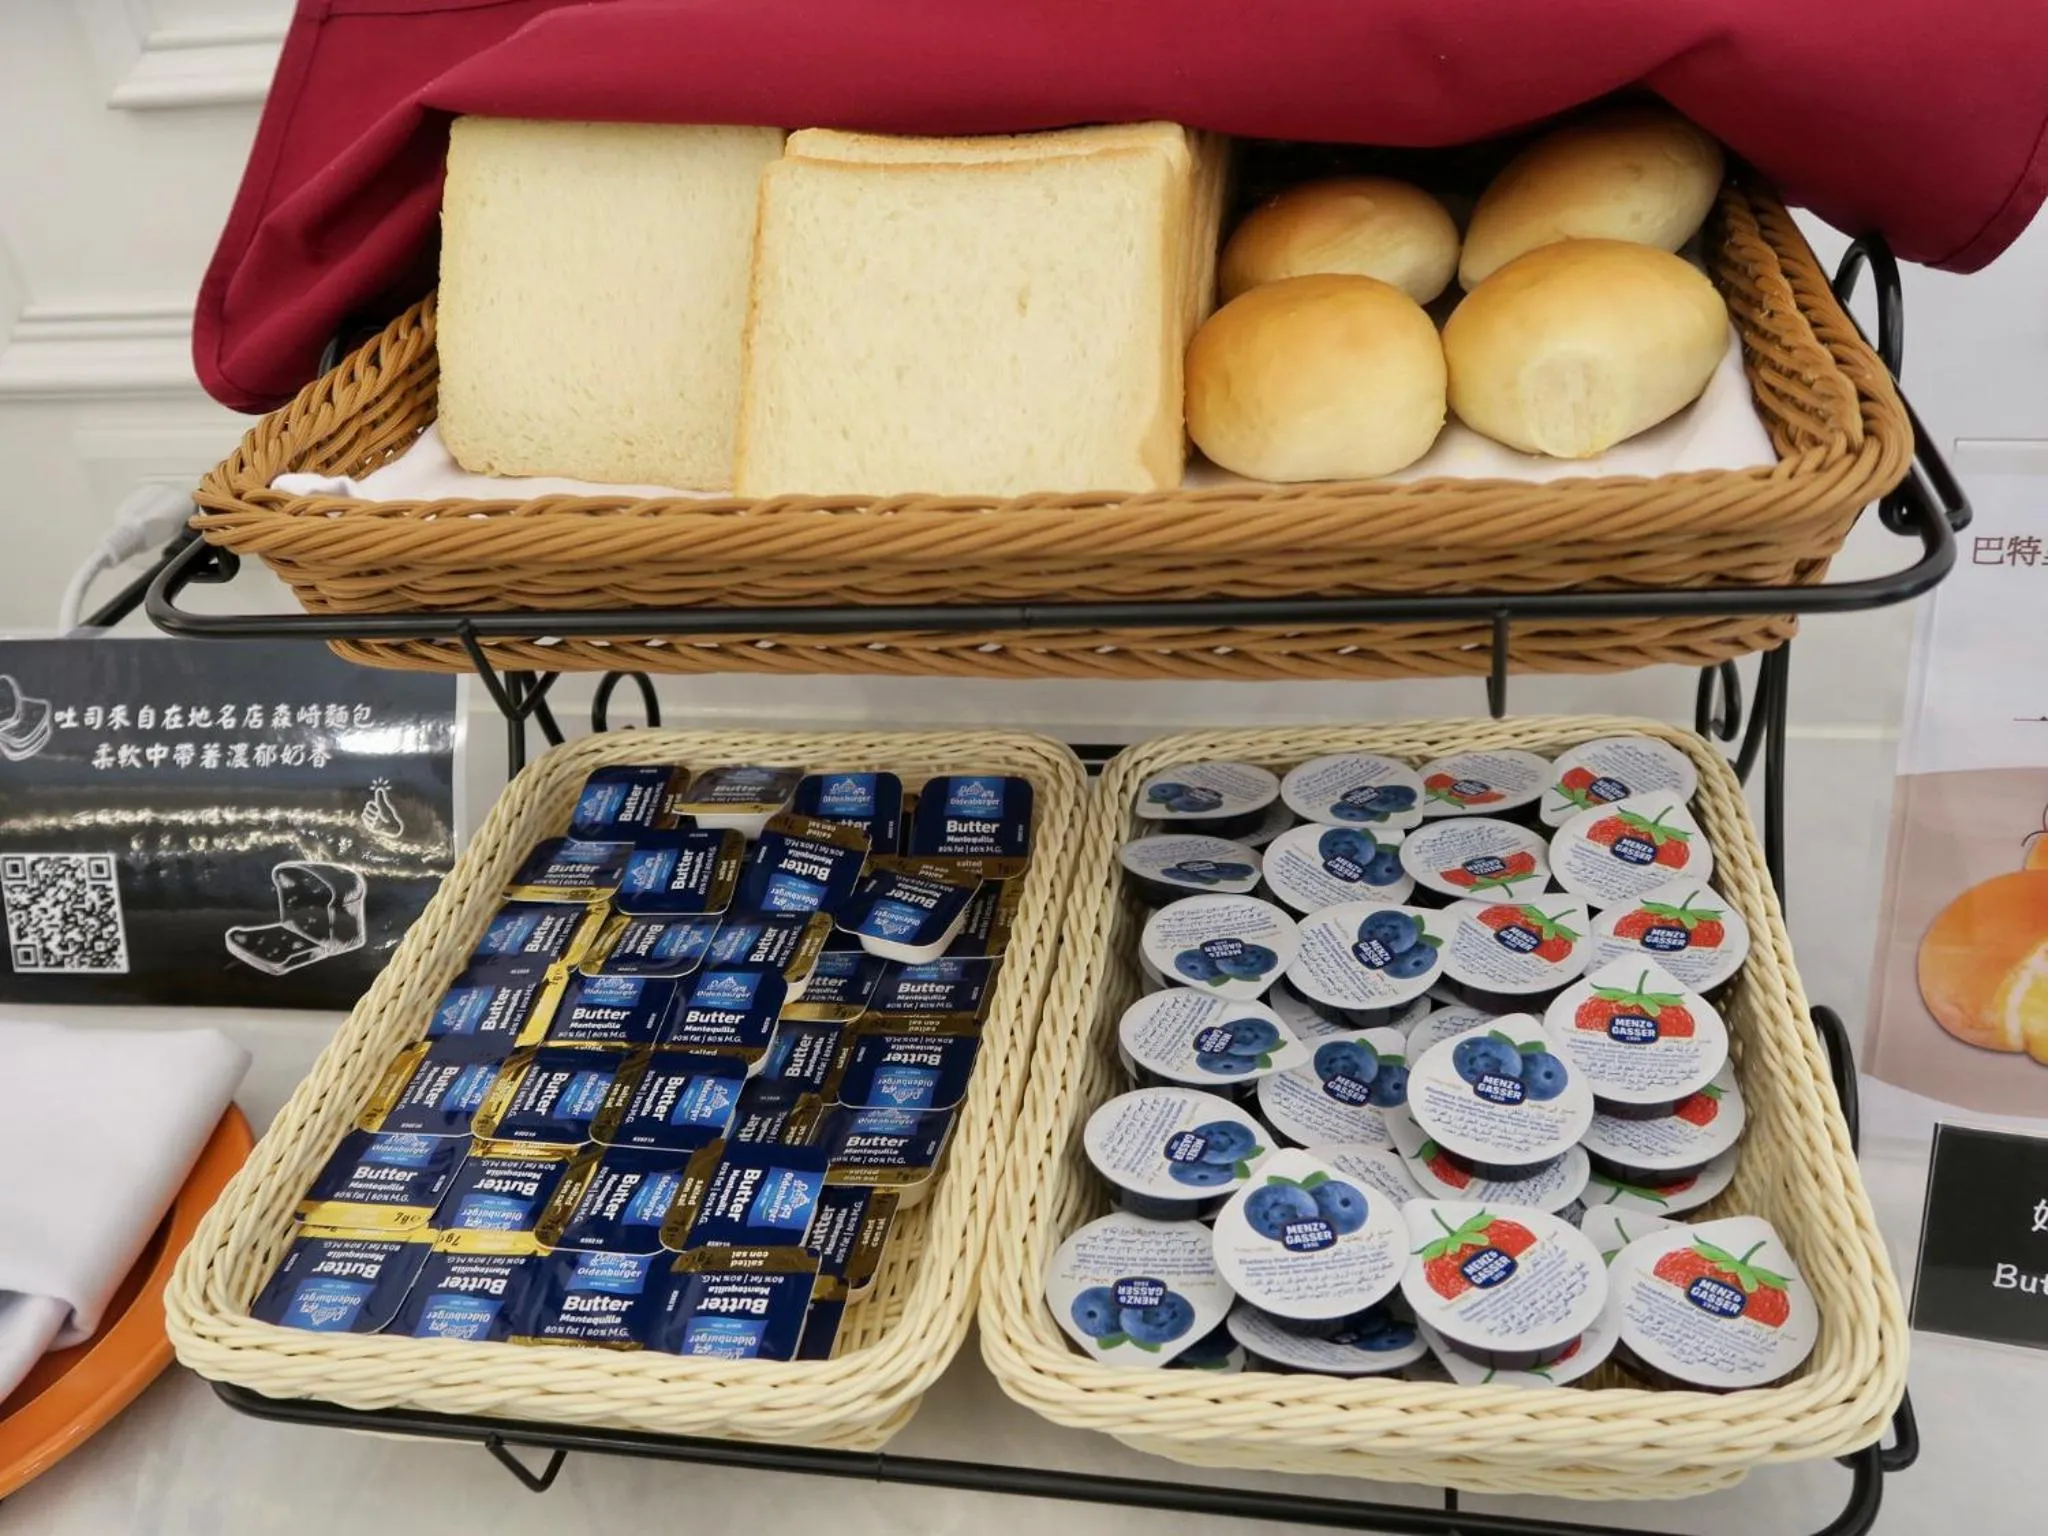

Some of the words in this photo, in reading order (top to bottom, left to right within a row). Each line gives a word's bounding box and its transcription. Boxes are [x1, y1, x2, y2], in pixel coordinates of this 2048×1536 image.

[1973, 535, 2048, 567] 巴特
[91, 740, 332, 770] 柔軟中帶著濃郁奶香
[619, 784, 645, 822] Butter
[946, 819, 1000, 834] Butter
[1614, 844, 1652, 861] GASSER
[548, 864, 600, 873] Butter
[671, 849, 694, 890] Butter
[778, 858, 831, 881] Butter
[1327, 859, 1360, 879] GASSER
[886, 888, 938, 909] Butter
[524, 914, 555, 953] Butter
[636, 924, 665, 957] Butter
[1500, 930, 1534, 951] GASSER
[1645, 935, 1686, 946] GASSER
[749, 927, 779, 963] Butter
[1360, 941, 1384, 967] GASSER
[898, 983, 955, 994] Butter
[481, 987, 512, 1031] Butter
[572, 1008, 630, 1021] Butter
[686, 1010, 744, 1025] Butter
[569, 1021, 621, 1030] Mantequilla
[684, 1025, 736, 1034] Mantequilla
[1611, 1027, 1656, 1037] GASSER
[1201, 1029, 1223, 1052] GASSER
[784, 1033, 813, 1078] Butter
[882, 1052, 941, 1066] Butter
[423, 1066, 460, 1108] Butter
[536, 1072, 571, 1116] Butter
[1327, 1080, 1367, 1102] GASSER
[1477, 1083, 1522, 1100] GASSER
[652, 1076, 685, 1122] Butter
[845, 1136, 908, 1147] Butter
[1172, 1134, 1195, 1160] GASSER
[352, 1166, 418, 1182] Butter
[486, 1169, 543, 1180] Mantequilla
[348, 1181, 405, 1192] Mantequilla
[473, 1179, 539, 1197] Butter
[714, 1169, 739, 1216] Mantequilla
[603, 1174, 640, 1222] Butter
[727, 1169, 762, 1223] Butter
[461, 1209, 523, 1221] Oldenburger
[1285, 1231, 1333, 1245] GASSER
[327, 1251, 386, 1262] Mantequilla
[730, 1259, 764, 1267] salted
[312, 1261, 381, 1279] Butter
[451, 1266, 511, 1276] Mantequilla
[577, 1267, 643, 1278] Oldenburger
[1470, 1255, 1512, 1285] GASSER
[438, 1276, 508, 1295] Butter
[708, 1286, 770, 1296] Mantequilla
[1117, 1285, 1164, 1296] GASSER
[562, 1296, 634, 1312] Butter
[697, 1297, 769, 1314] Butter
[1690, 1286, 1741, 1314] GASSER
[426, 1311, 491, 1322] Oldenburger
[559, 1314, 622, 1325] Mantequilla
[688, 1335, 756, 1347] Oldenburger
